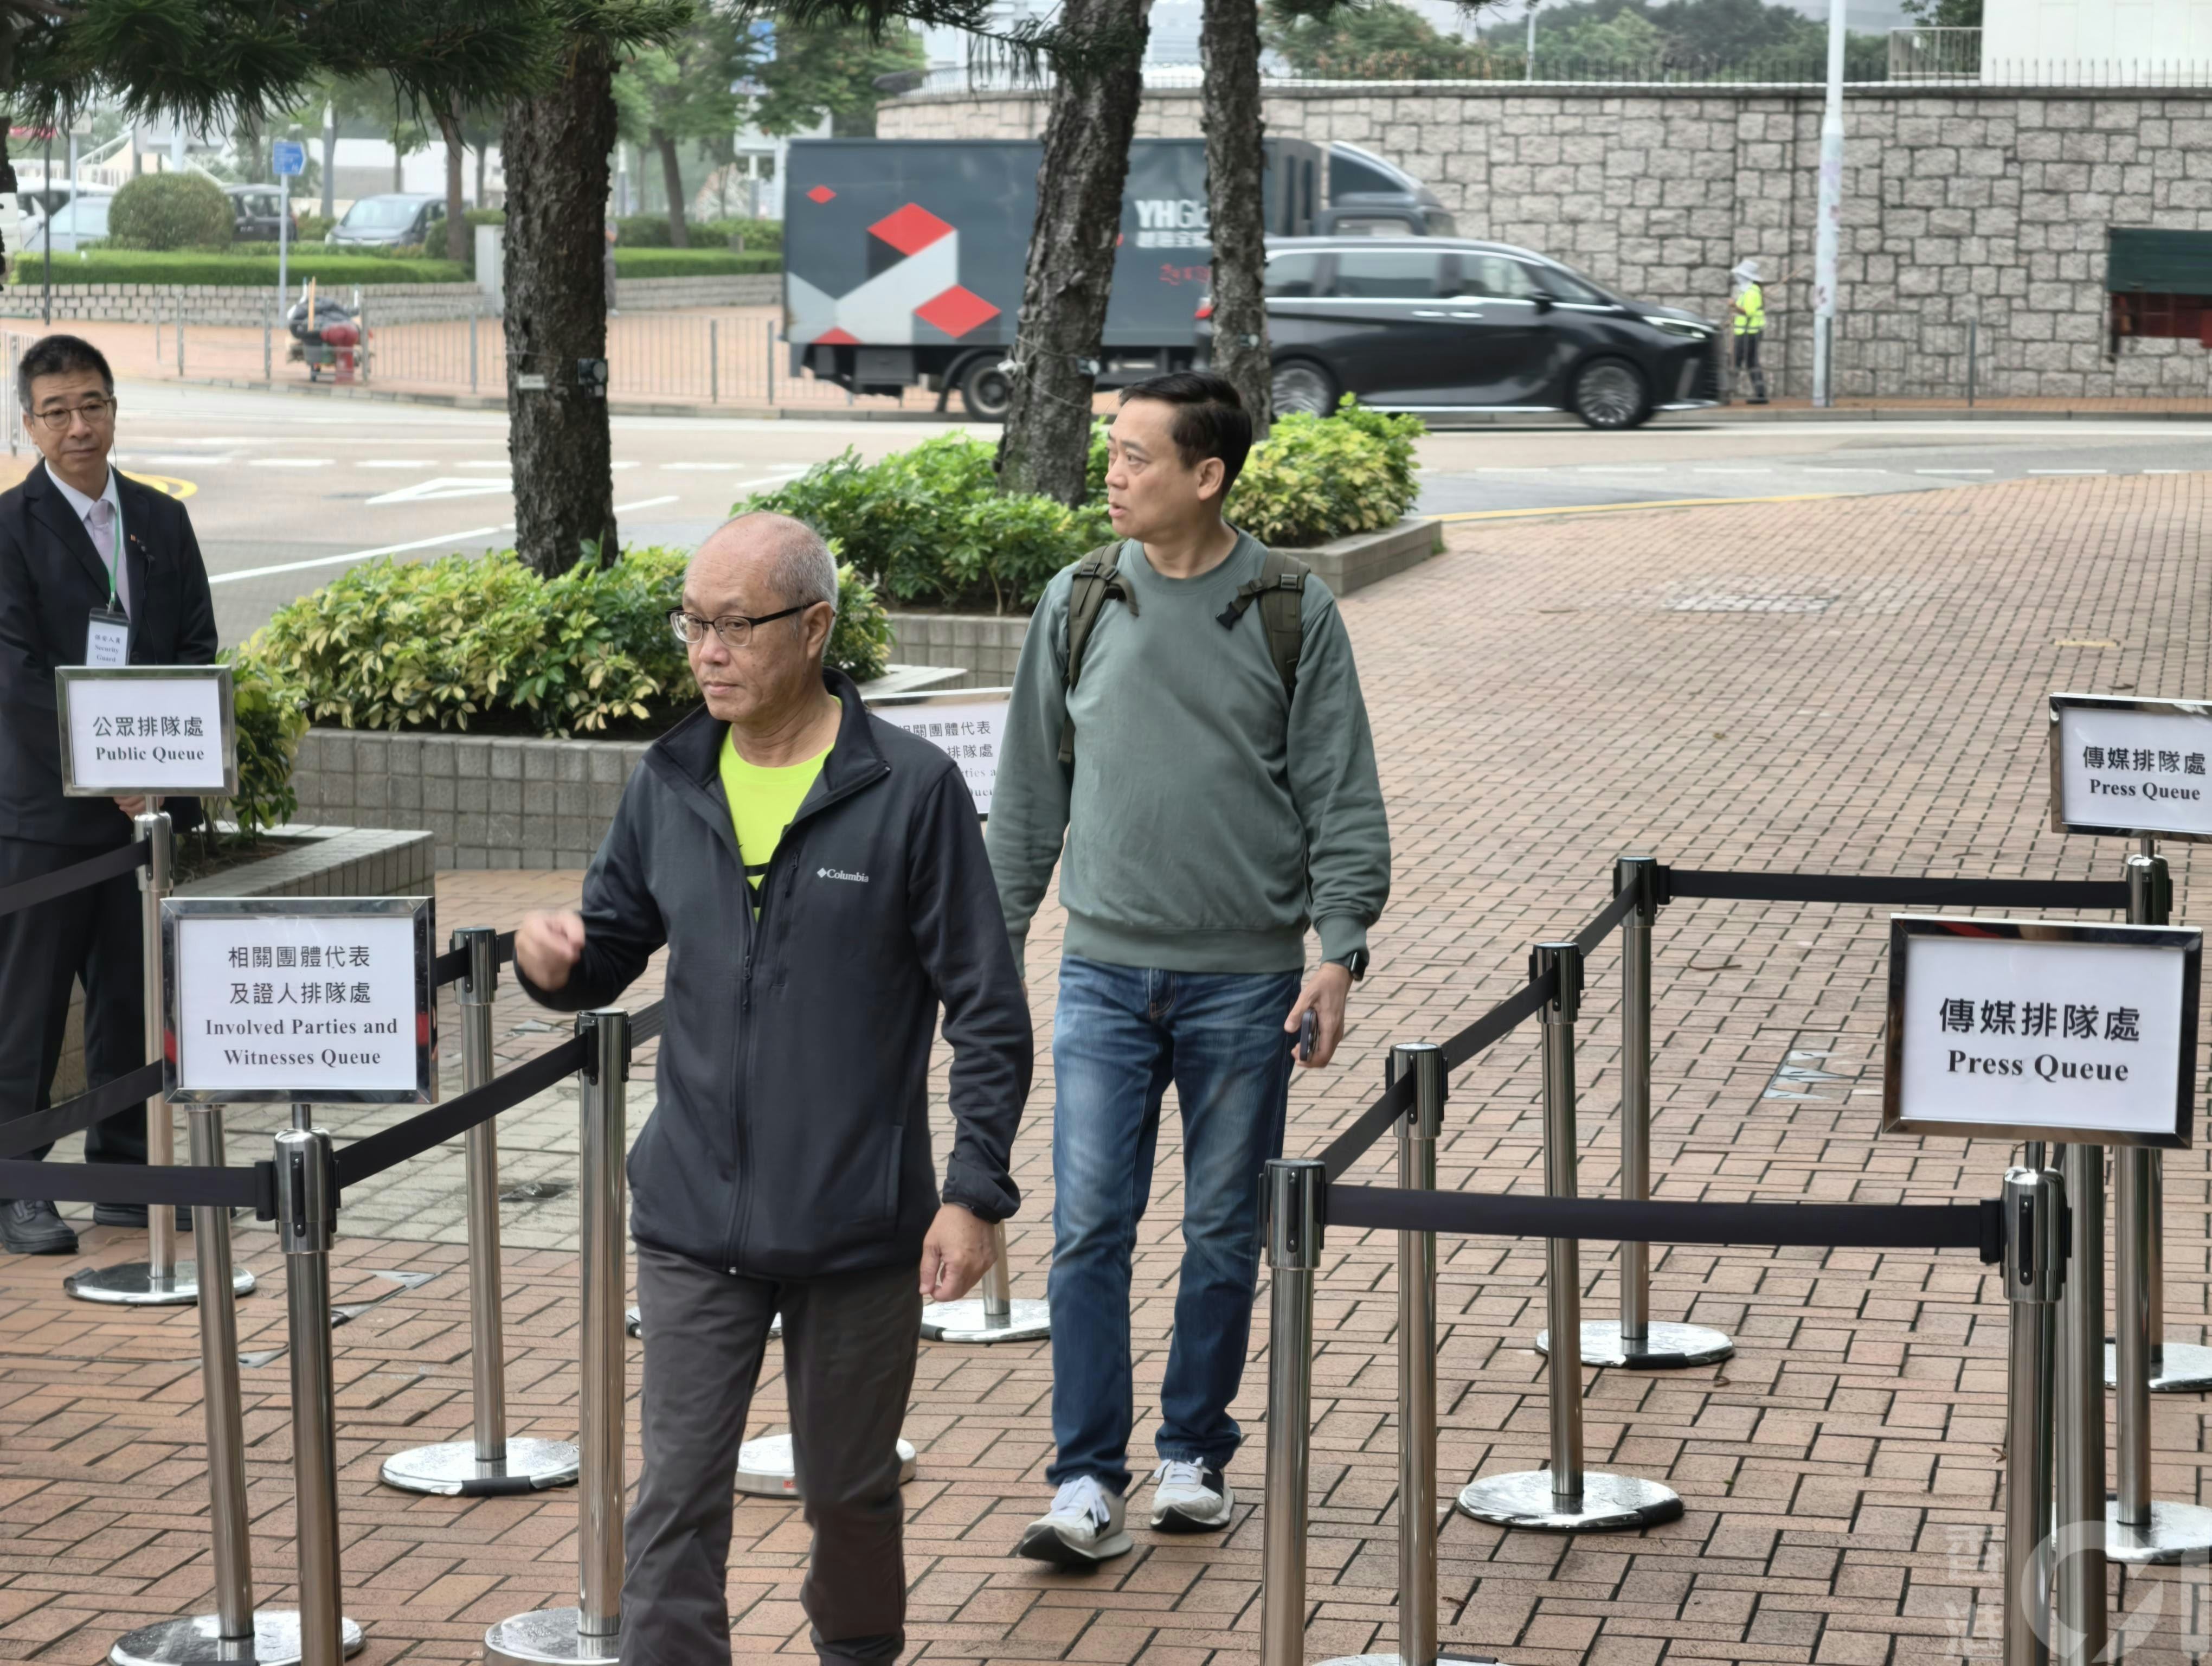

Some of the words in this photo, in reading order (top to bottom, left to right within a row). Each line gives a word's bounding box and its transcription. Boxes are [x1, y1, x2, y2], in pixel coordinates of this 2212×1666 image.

[94, 645, 119, 655] Security
[96, 654, 116, 662] Guard
[93, 716, 203, 737] 公眾排隊處
[95, 746, 146, 761] Public
[152, 746, 204, 764] Queue
[2082, 745, 2206, 776] 傳媒排隊處
[2089, 778, 2137, 797] Press
[2142, 781, 2201, 802] Queue
[826, 869, 869, 882] Columbia
[228, 945, 370, 969] 相關團體代表
[229, 981, 371, 1005] 及證人排隊處
[205, 1019, 285, 1035] Involved
[292, 1018, 357, 1035] Parties
[363, 1018, 398, 1034] and
[1939, 997, 2140, 1042] 傳媒排隊處
[223, 1048, 314, 1065] Witnesses
[320, 1048, 381, 1068] Queue
[1947, 1049, 2023, 1077] Press
[2034, 1054, 2129, 1084] Queue
